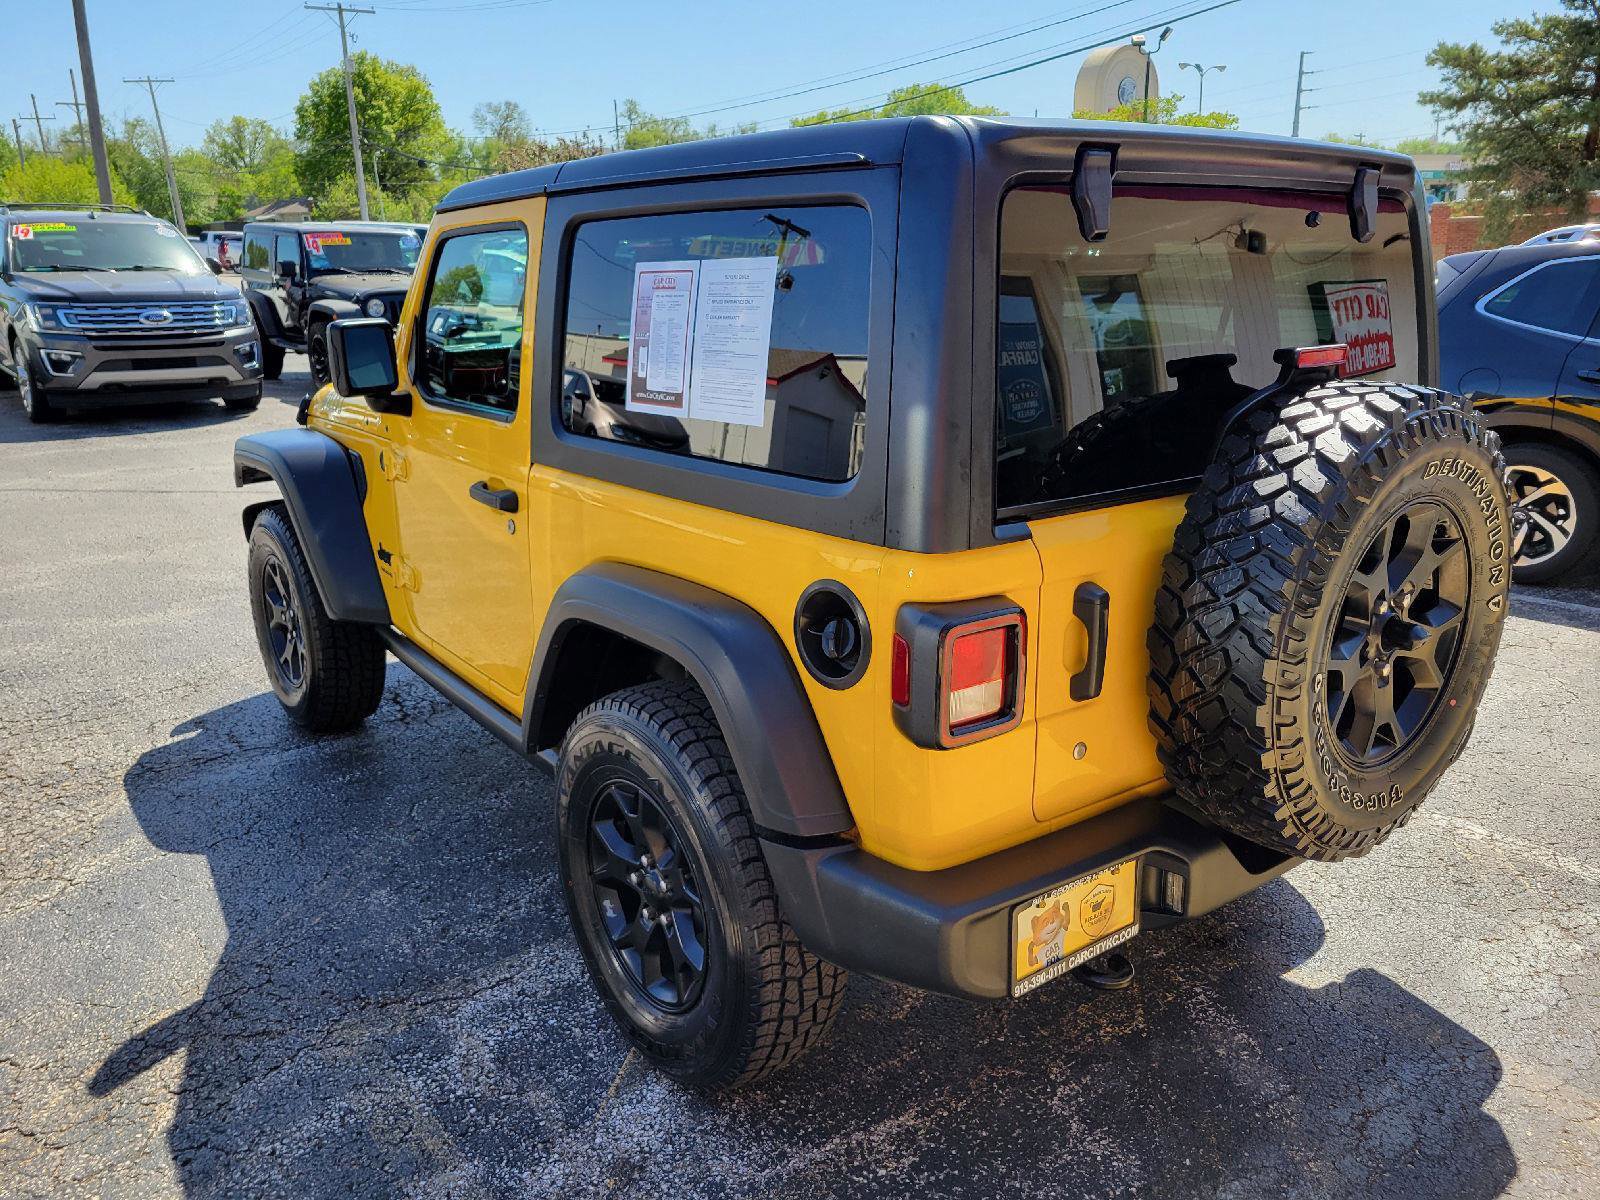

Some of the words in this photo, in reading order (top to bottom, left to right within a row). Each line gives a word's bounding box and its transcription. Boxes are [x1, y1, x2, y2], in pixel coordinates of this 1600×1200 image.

[1424, 458, 1505, 588] DESTINATION
[1014, 962, 1067, 996] 913-390-0111
[1068, 924, 1139, 967] CARCITYKC.COM
[1045, 942, 1060, 958] CAR
